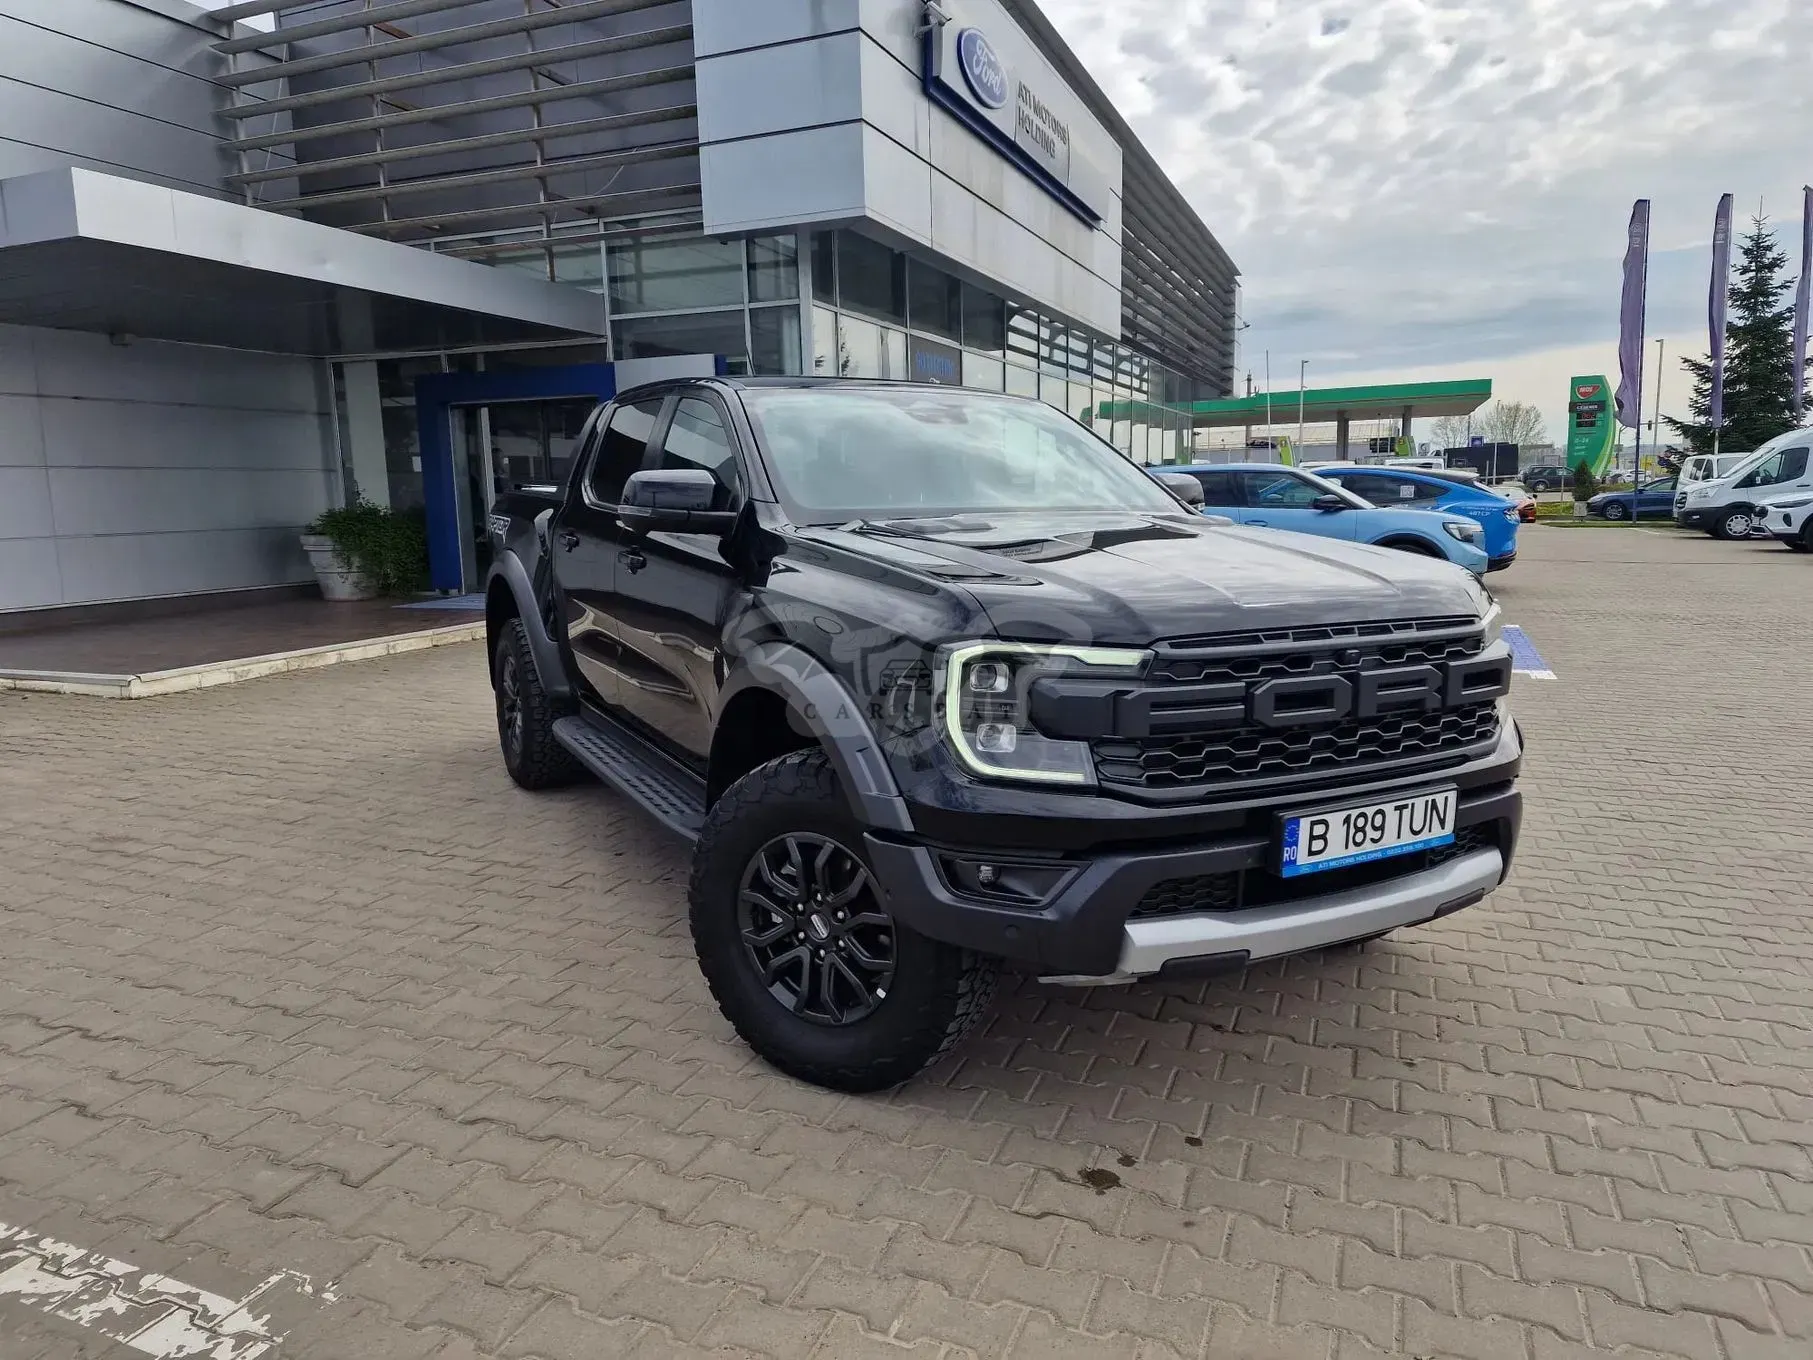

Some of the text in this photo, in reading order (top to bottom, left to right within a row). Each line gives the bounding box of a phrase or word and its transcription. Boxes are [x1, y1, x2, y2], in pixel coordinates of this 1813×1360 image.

[973, 39, 1002, 95] Ford
[1018, 80, 1067, 145] ATI MOTORS
[1018, 105, 1056, 159] HOLDING
[1115, 640, 1513, 738] FORD
[1283, 846, 1297, 861] RO
[1308, 795, 1449, 857] B 189 TUN
